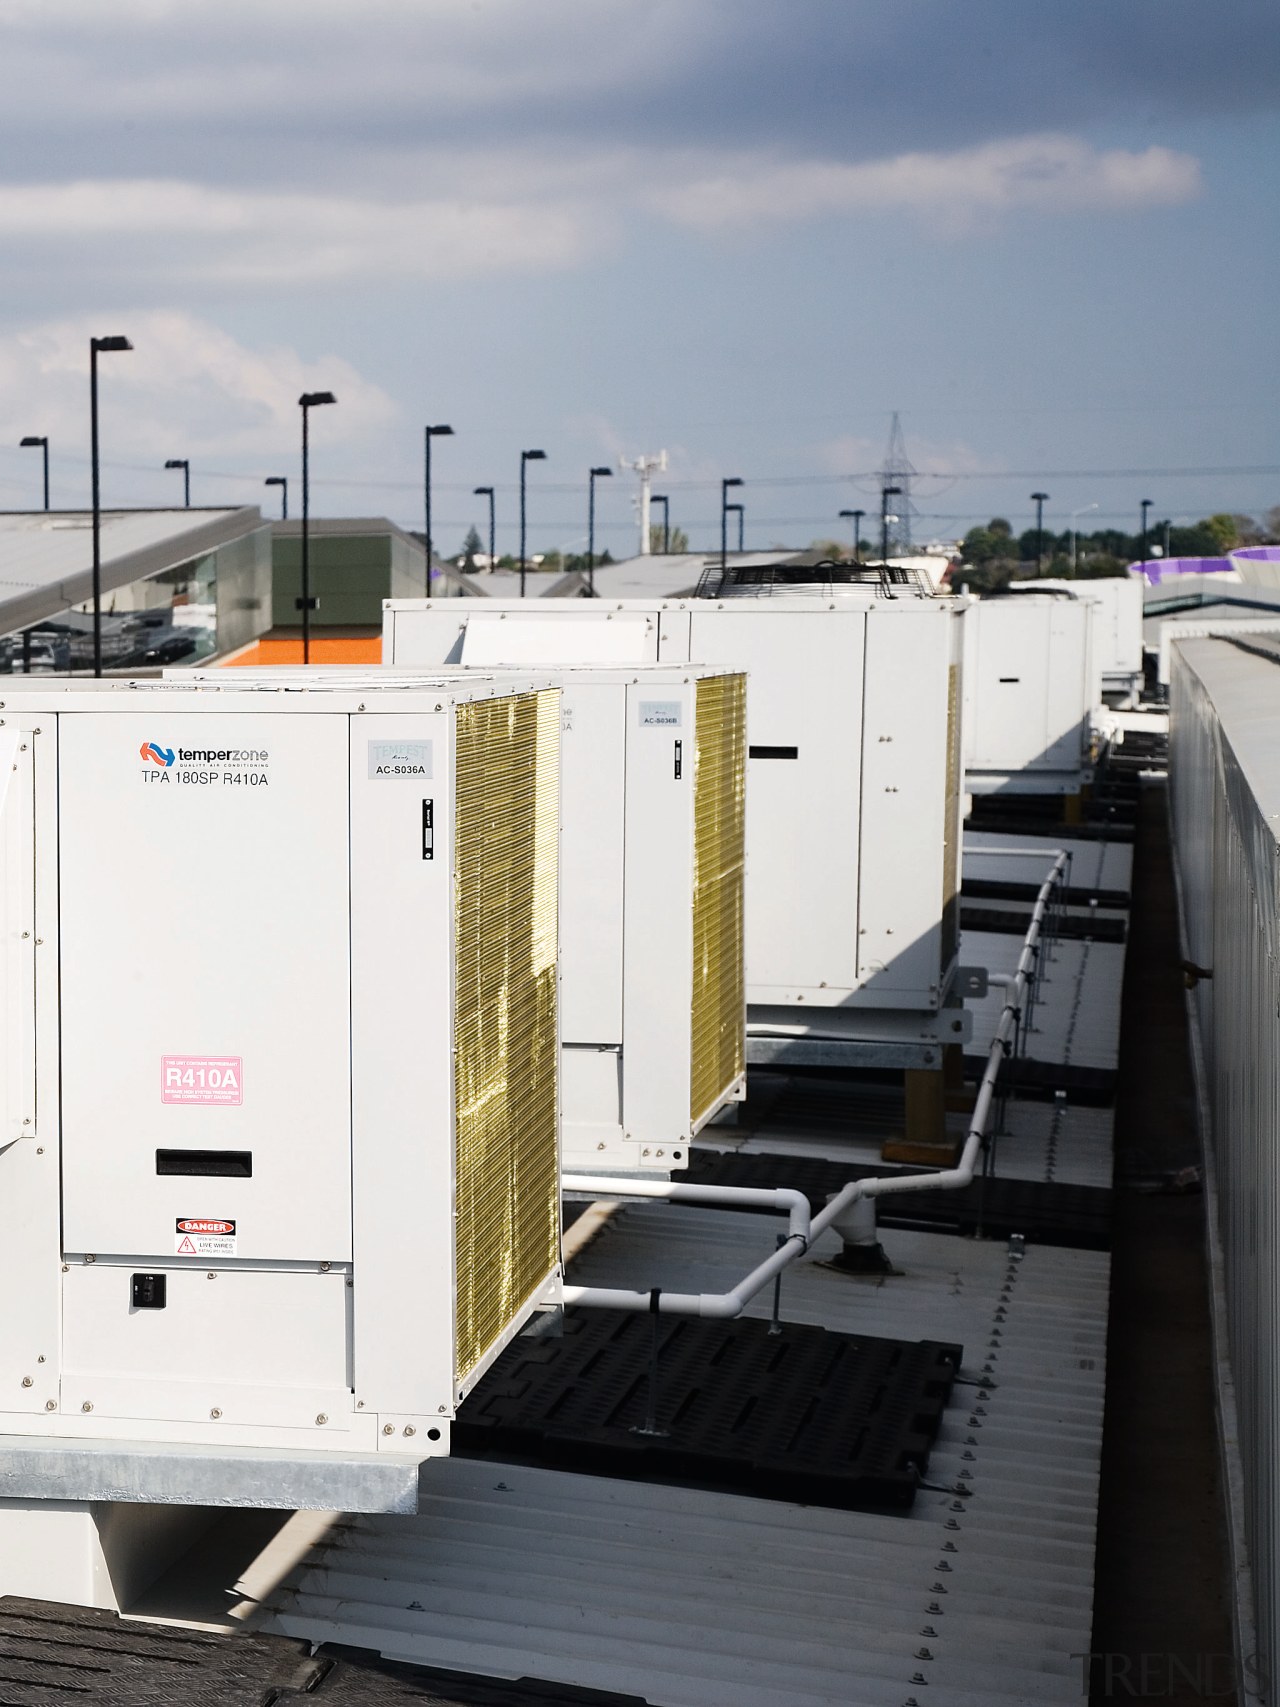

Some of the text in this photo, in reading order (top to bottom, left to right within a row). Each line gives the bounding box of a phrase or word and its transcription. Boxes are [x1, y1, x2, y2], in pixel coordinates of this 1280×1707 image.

[178, 748, 269, 763] temperzone
[376, 765, 426, 774] AC-S036A
[142, 770, 269, 786] TPA 180SP R410A
[166, 1067, 239, 1089] R410A
[184, 1222, 226, 1232] DANGER
